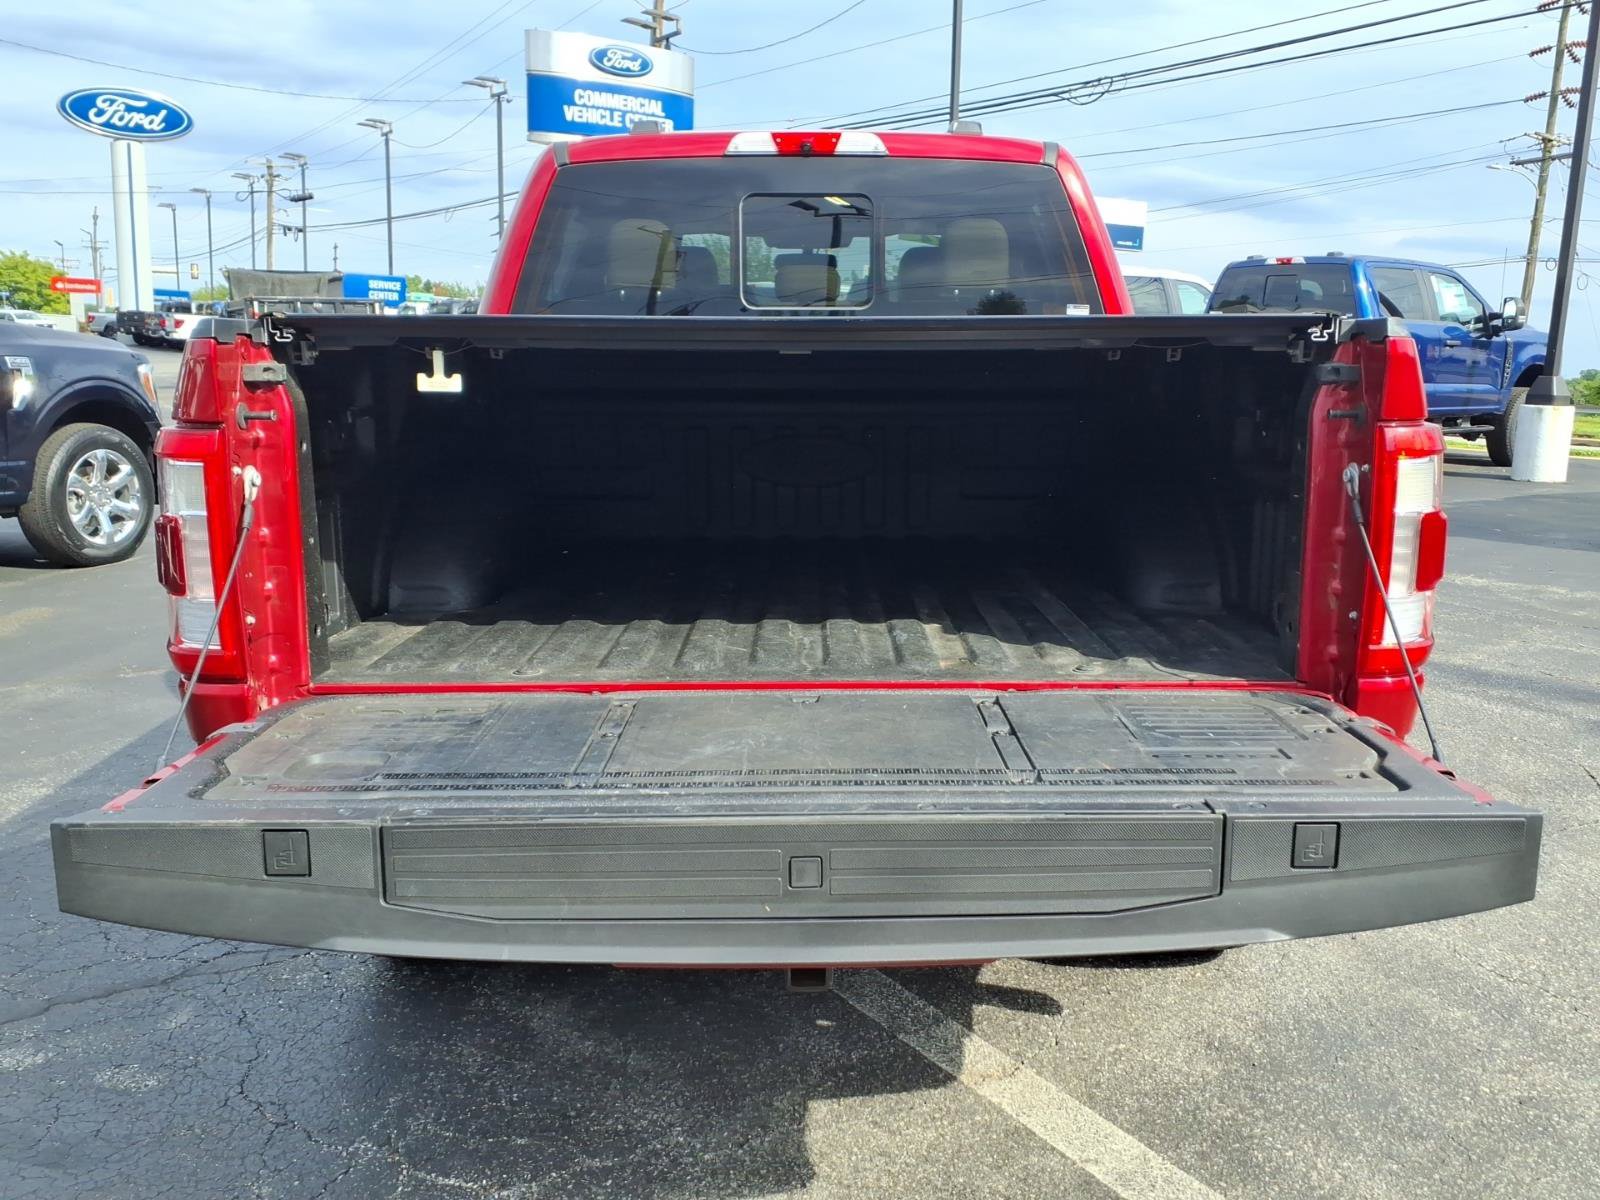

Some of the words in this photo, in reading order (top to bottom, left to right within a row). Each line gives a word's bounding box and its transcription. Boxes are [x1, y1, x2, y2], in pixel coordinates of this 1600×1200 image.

[603, 48, 643, 72] Ford
[88, 94, 168, 131] Ford
[574, 88, 666, 118] COMMERCIAL
[563, 104, 623, 128] VEHICLE
[367, 279, 402, 291] SERVICE
[367, 290, 400, 301] CENTER
